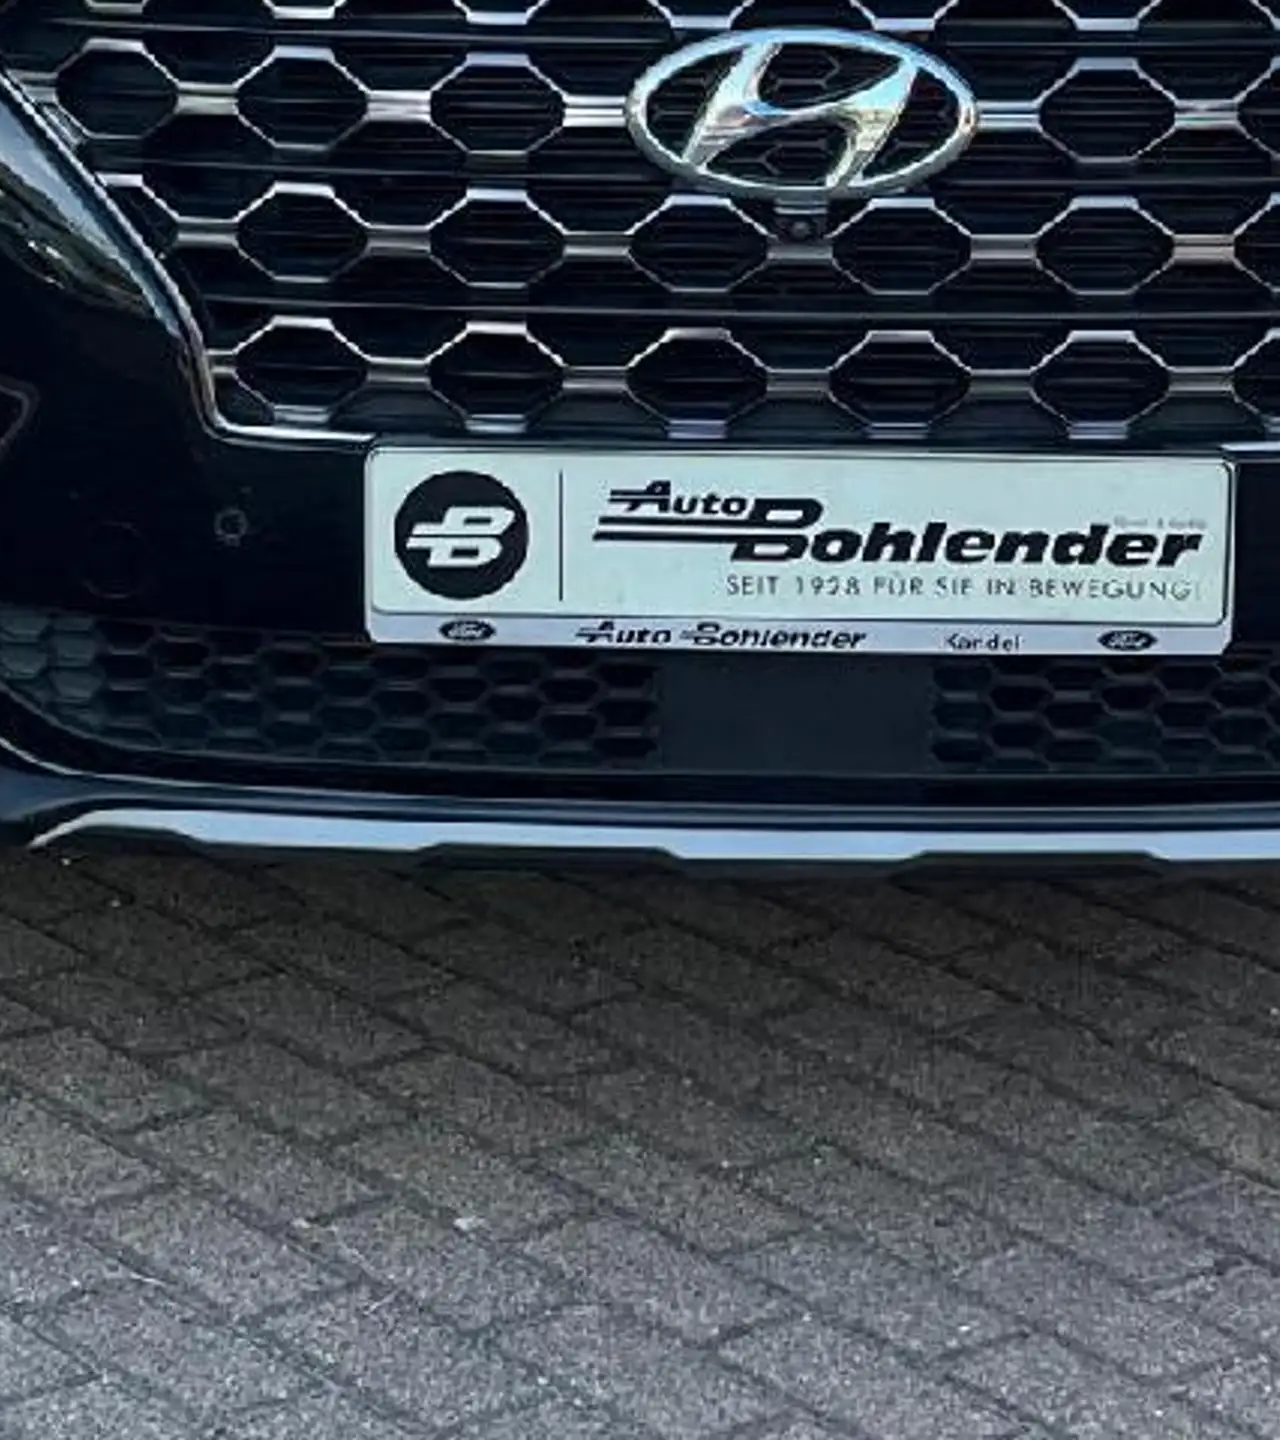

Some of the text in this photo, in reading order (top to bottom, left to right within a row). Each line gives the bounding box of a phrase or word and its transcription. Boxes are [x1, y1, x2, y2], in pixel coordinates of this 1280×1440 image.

[608, 480, 747, 516] Auto
[593, 498, 1202, 567] Bohlender
[726, 575, 777, 596] SEIT
[798, 575, 861, 596] 1928
[873, 570, 923, 597] FÜR
[987, 578, 1016, 597] IN
[575, 622, 672, 645] Auto
